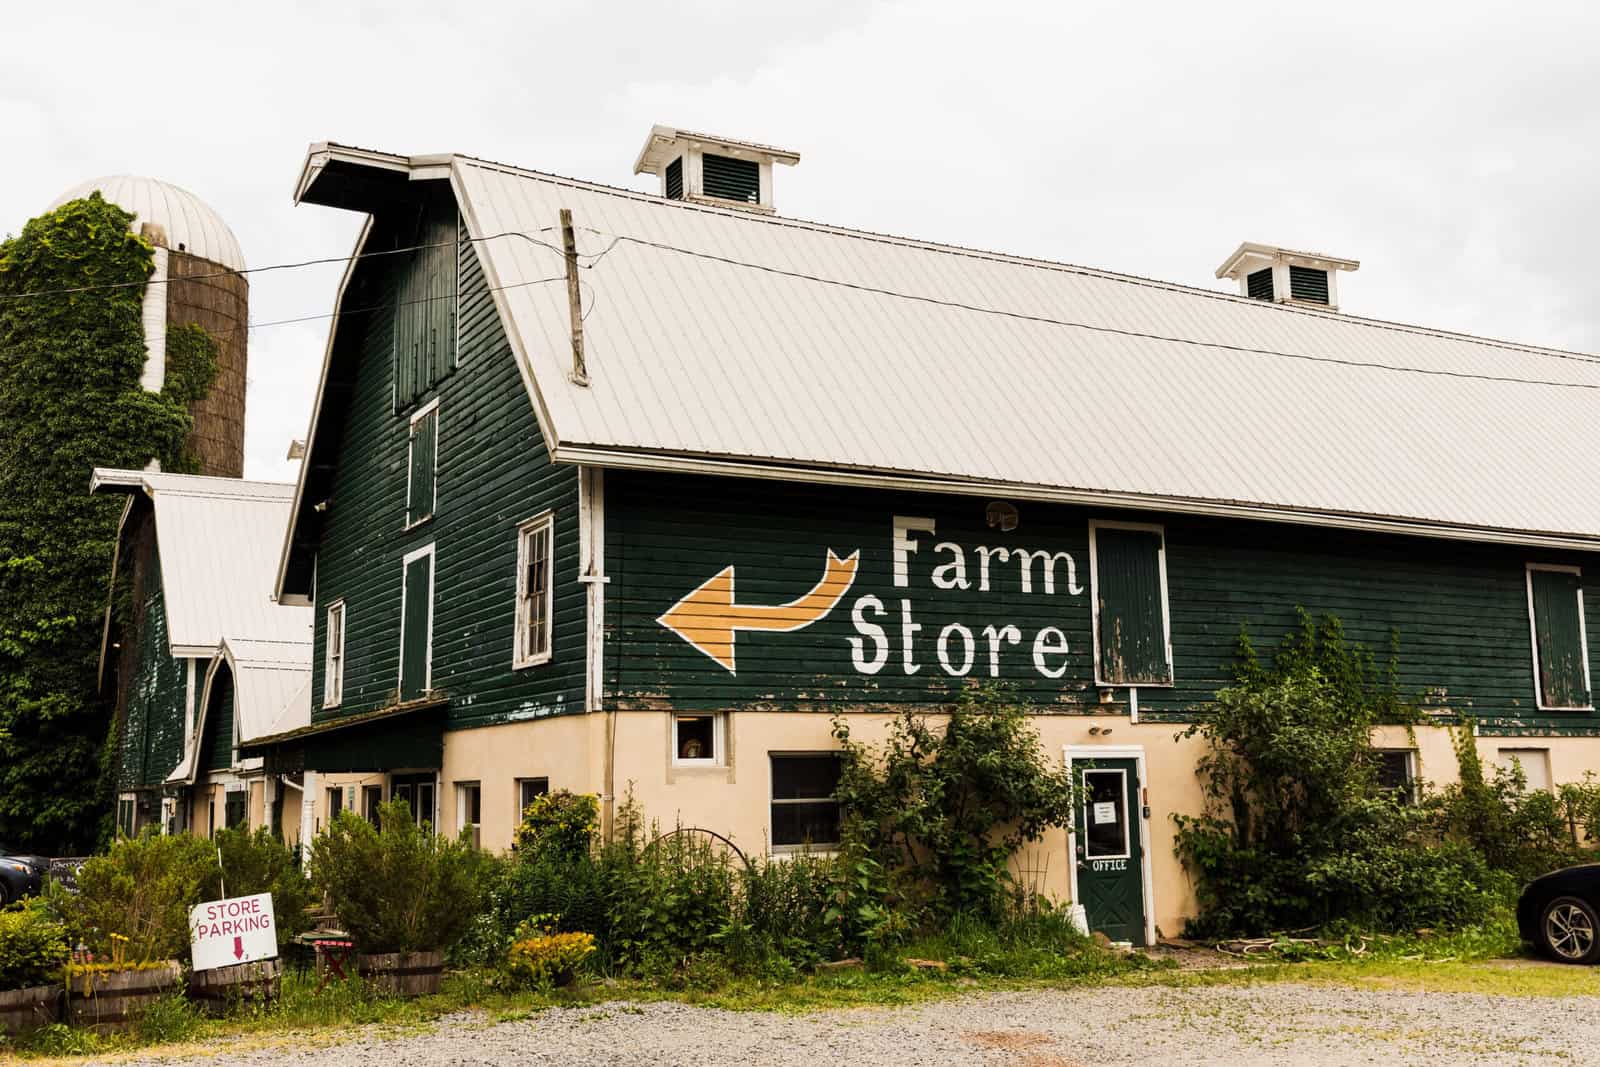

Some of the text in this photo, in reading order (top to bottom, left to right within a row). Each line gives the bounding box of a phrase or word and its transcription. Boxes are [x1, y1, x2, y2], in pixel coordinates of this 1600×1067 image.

[893, 515, 1084, 595] Farm
[844, 594, 1069, 678] Store
[1092, 859, 1127, 871] OFFICE
[207, 898, 260, 921] STORE
[198, 914, 270, 939] PARKING
